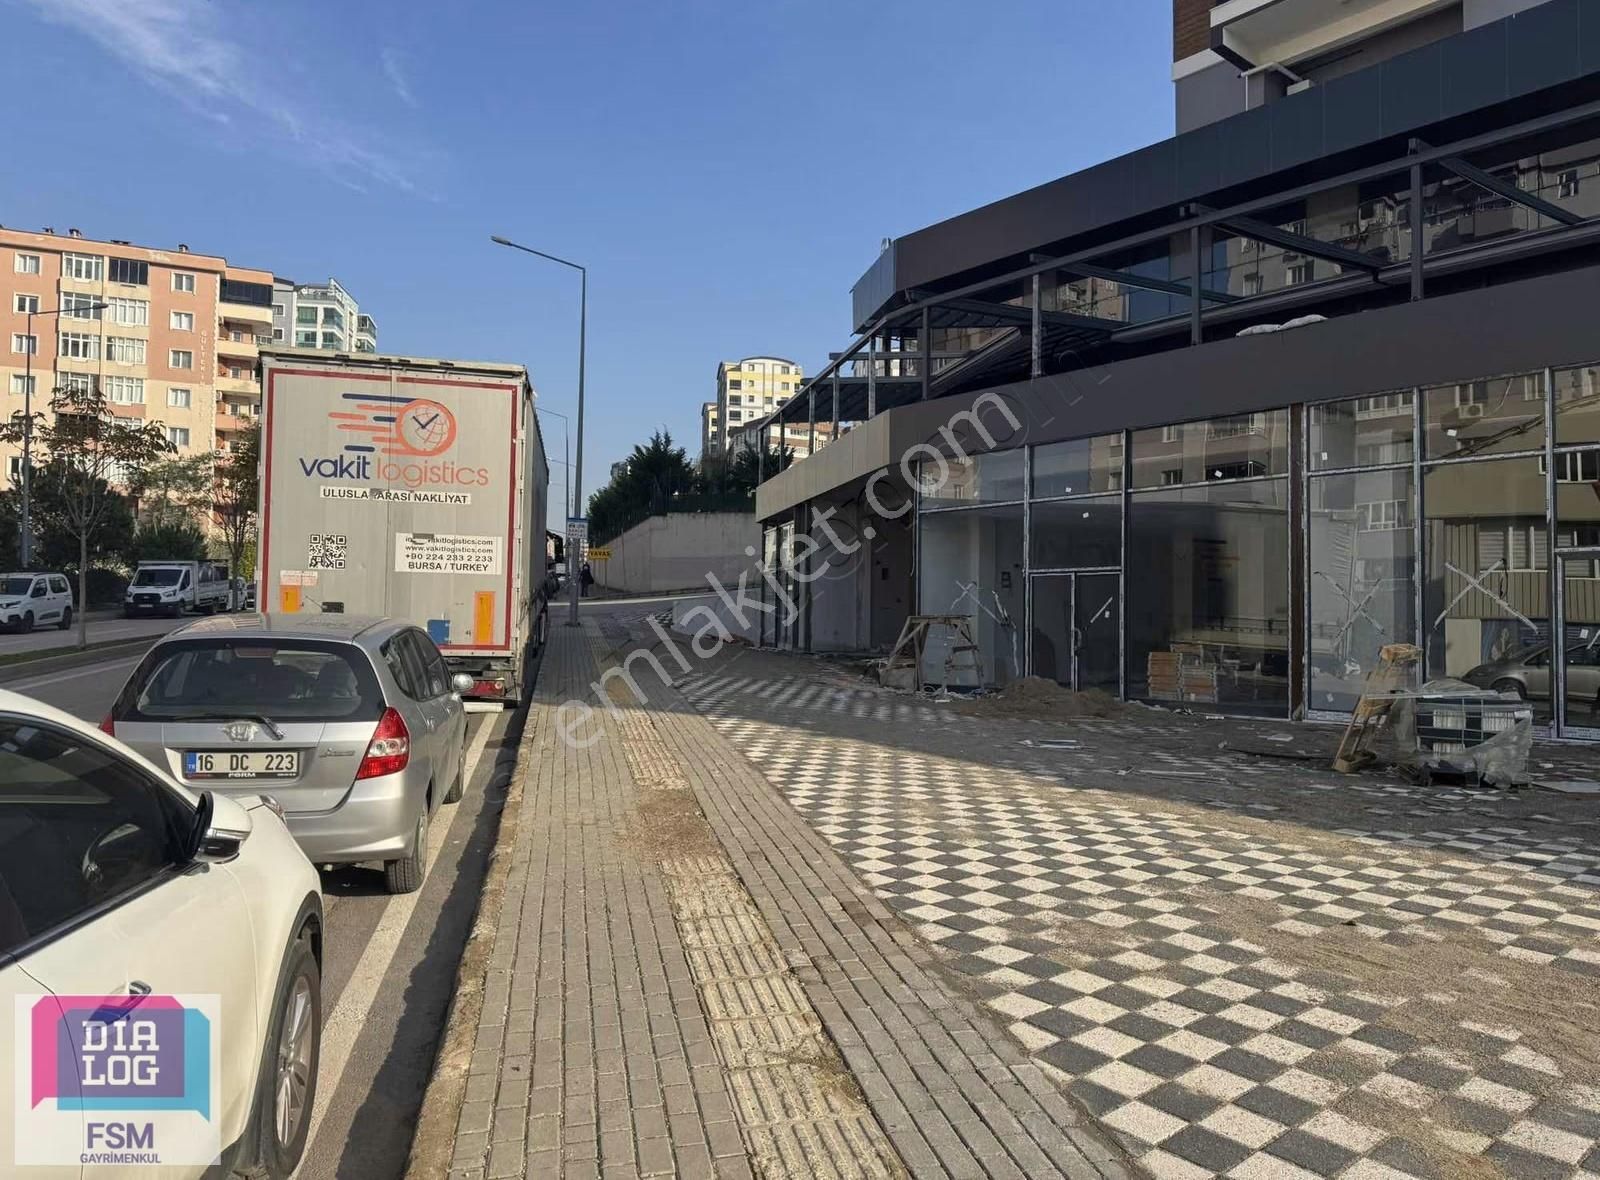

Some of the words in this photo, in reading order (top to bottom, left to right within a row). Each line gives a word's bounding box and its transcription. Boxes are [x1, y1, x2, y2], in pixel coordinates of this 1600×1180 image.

[299, 454, 371, 480] vakit
[376, 457, 489, 488] logistics
[322, 488, 411, 501] ULUSLAARASI
[414, 491, 469, 504] NAKLİYAT
[405, 545, 494, 553] www.vakitlogistics.com
[408, 561, 442, 570] BURSA
[449, 563, 489, 571] TURKEY
[198, 754, 214, 771] 16
[230, 754, 249, 771] DC
[265, 754, 294, 771] 223
